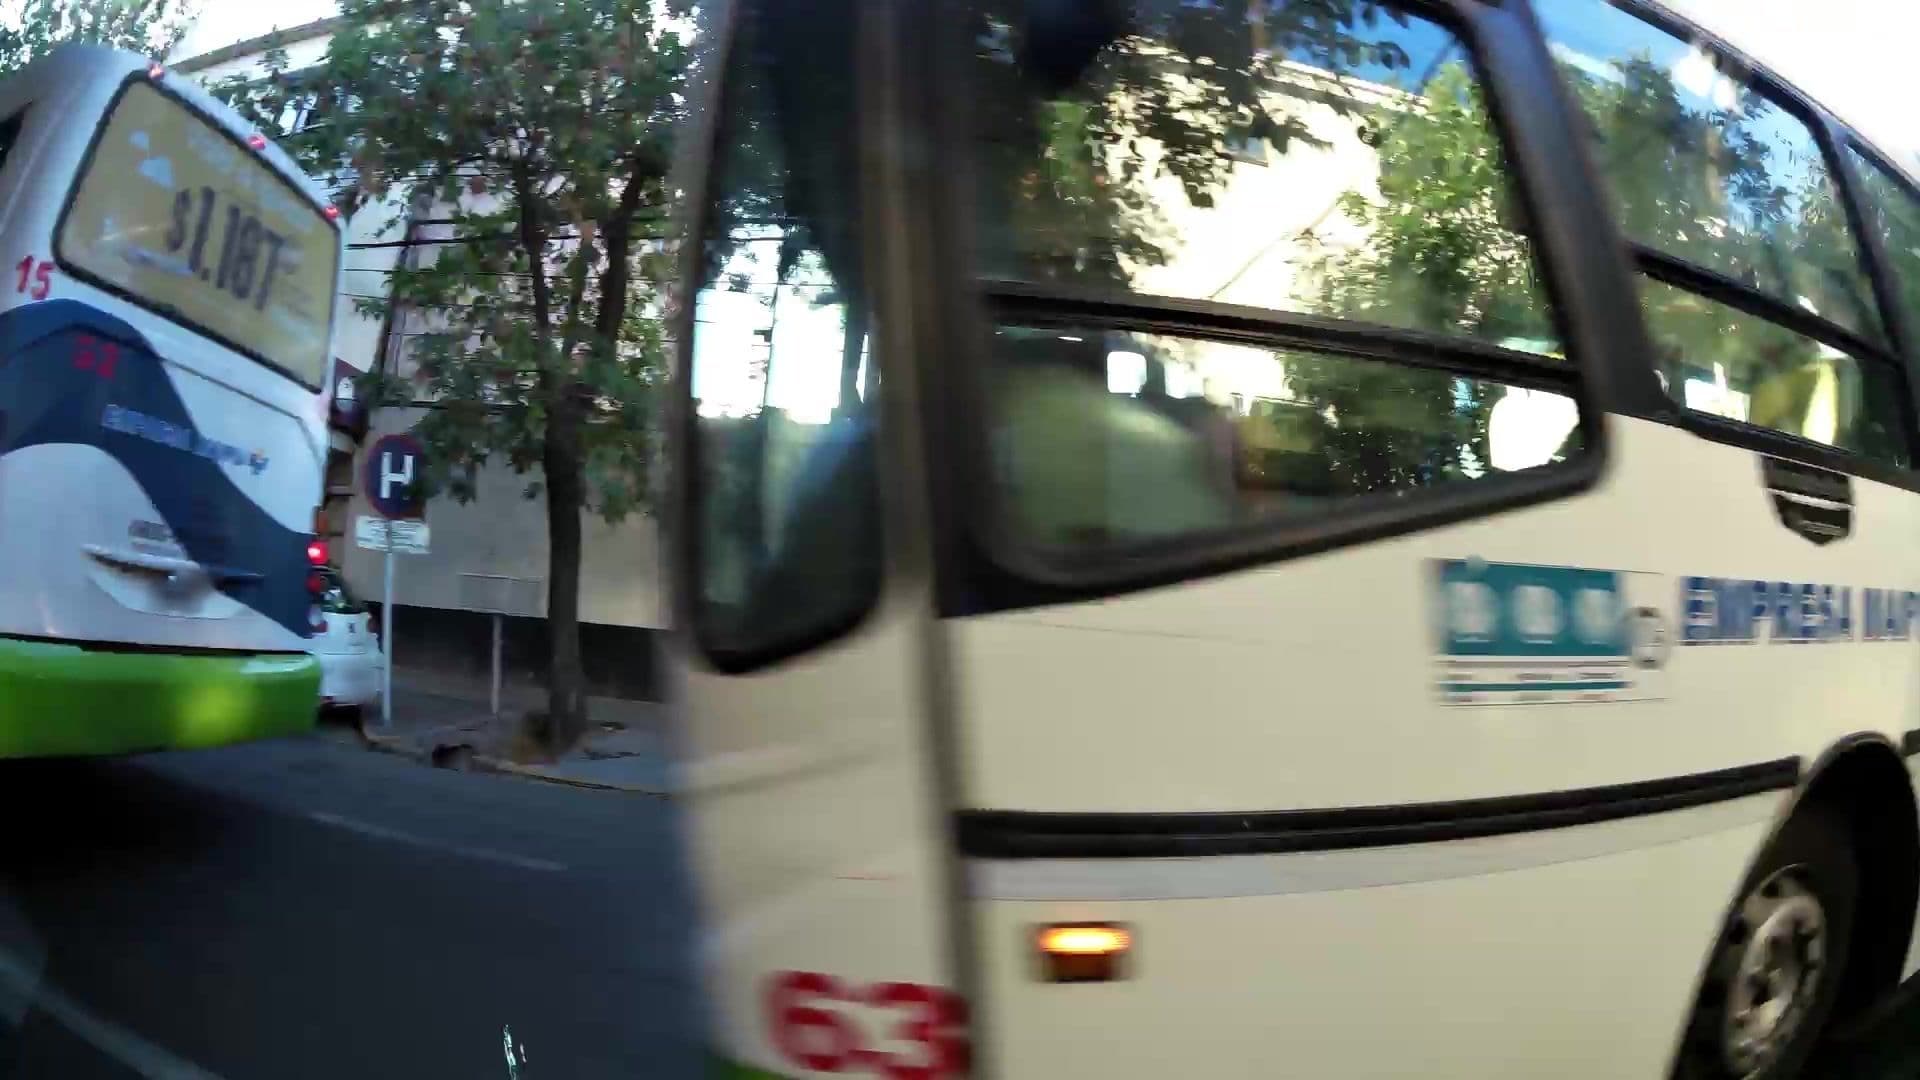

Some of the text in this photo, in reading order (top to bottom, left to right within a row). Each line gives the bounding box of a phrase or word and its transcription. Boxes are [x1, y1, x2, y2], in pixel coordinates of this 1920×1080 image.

[16, 254, 54, 300] 15
[1681, 576, 1853, 644] EMPRESA
[763, 971, 973, 1080] 63
